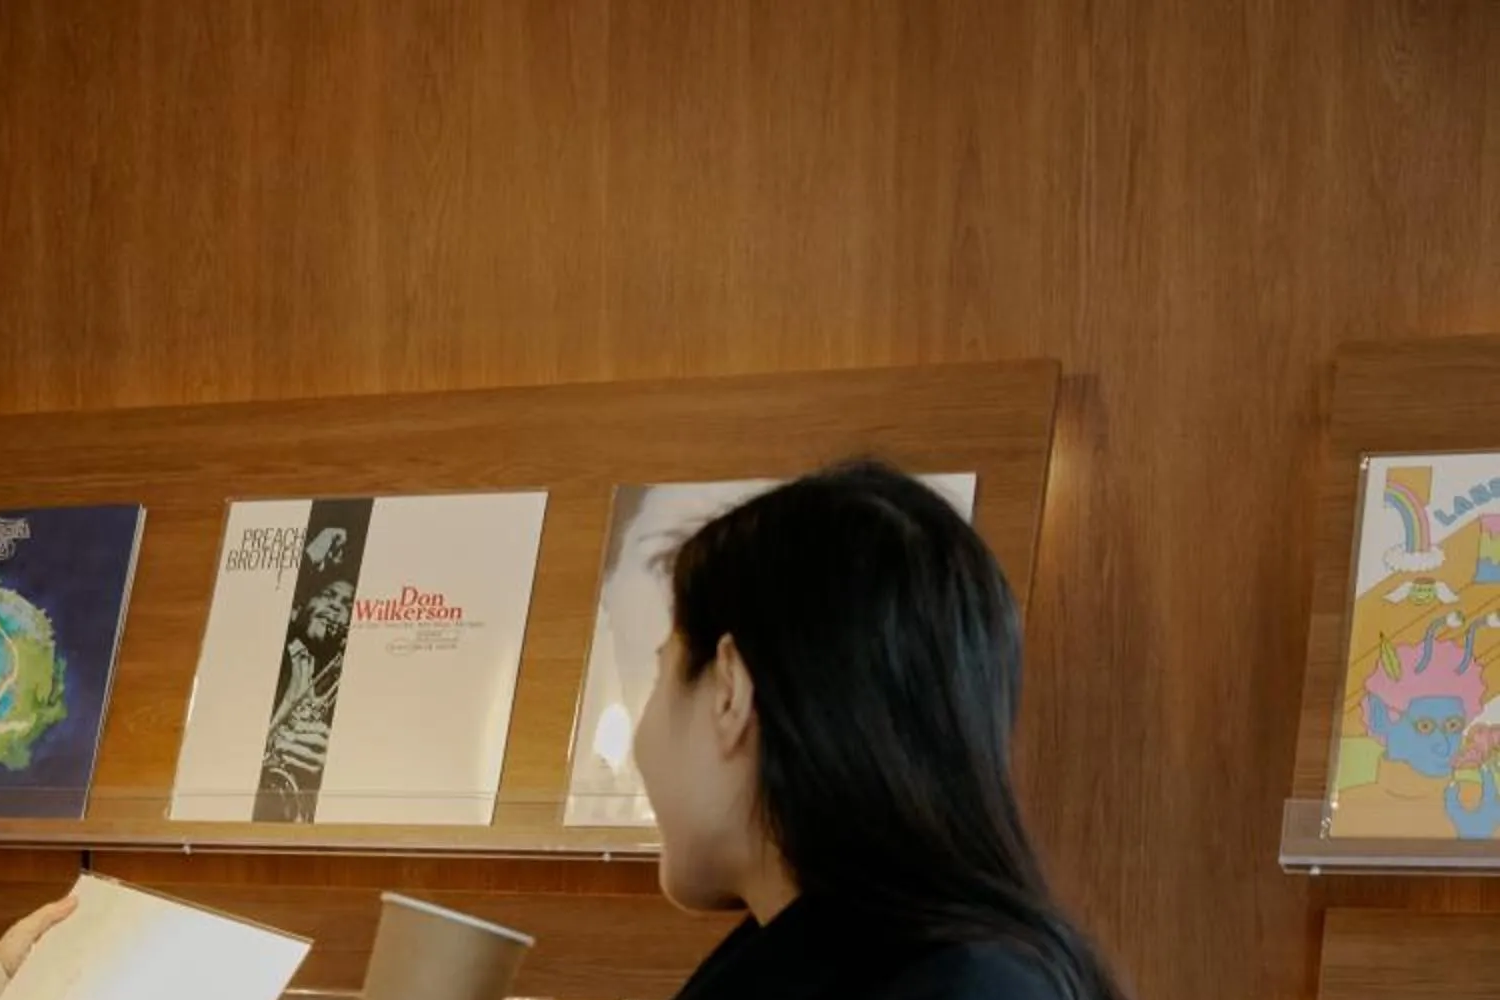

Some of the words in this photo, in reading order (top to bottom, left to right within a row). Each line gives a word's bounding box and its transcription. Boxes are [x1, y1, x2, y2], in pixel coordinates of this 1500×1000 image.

[241, 527, 308, 550] PREACH
[401, 586, 445, 608] Don
[354, 598, 463, 622] Wilkerson
